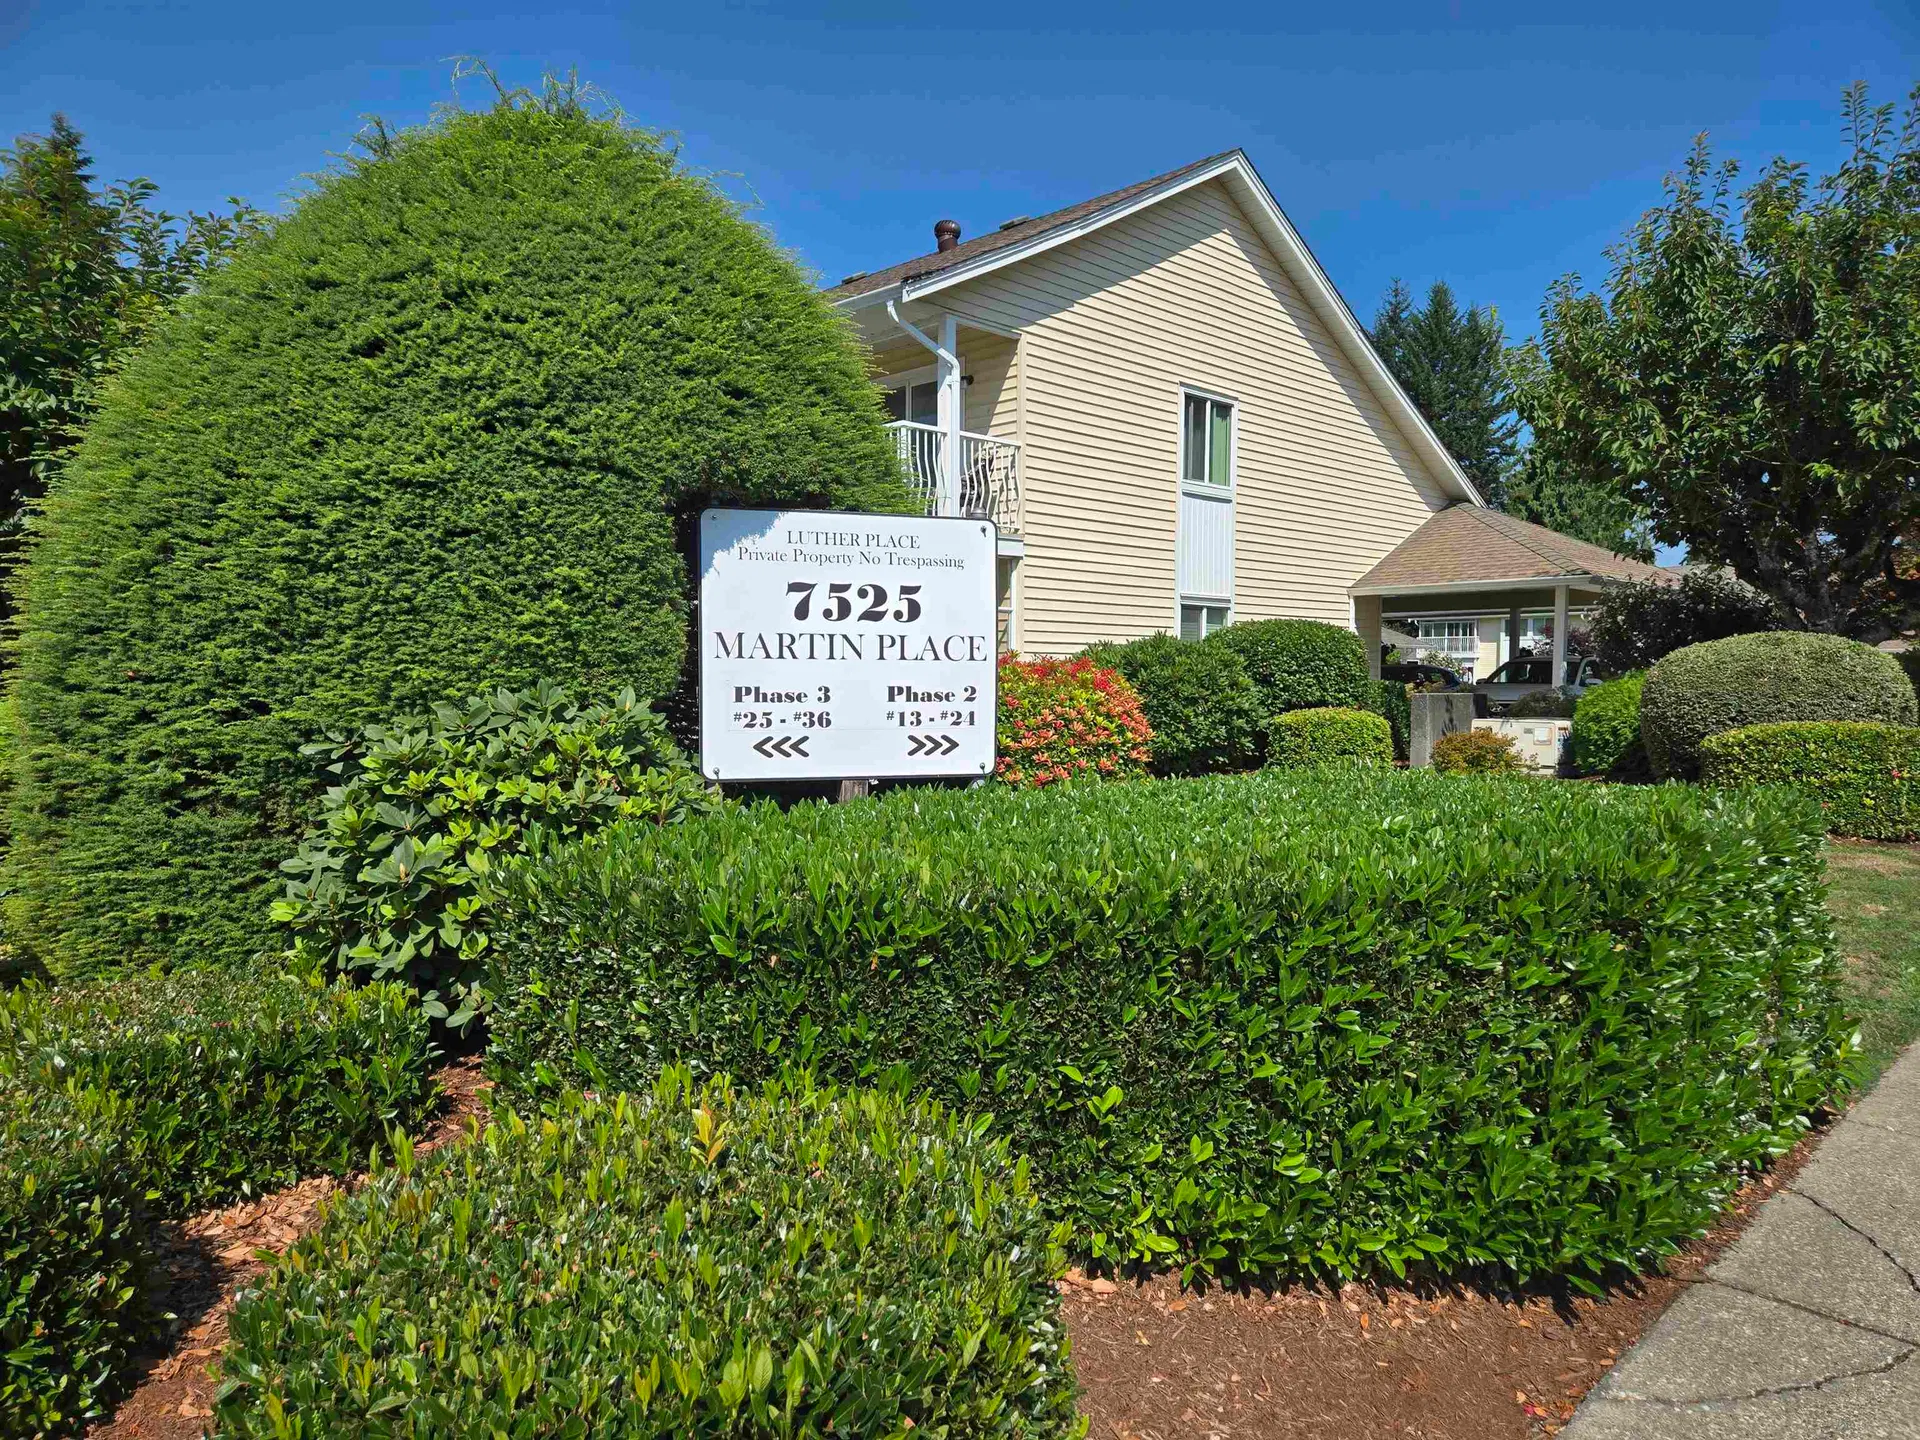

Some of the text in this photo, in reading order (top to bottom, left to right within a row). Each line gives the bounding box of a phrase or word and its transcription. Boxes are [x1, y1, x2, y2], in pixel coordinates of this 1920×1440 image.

[787, 530, 920, 549] LUTHER PLACE
[738, 547, 964, 570] Private Property No Trespassing
[786, 581, 922, 623] 7525
[713, 632, 988, 661] MARTIN PLACE
[733, 686, 831, 703] Phase 3
[887, 686, 977, 702] Phase 2
[734, 712, 772, 728] #25
[794, 711, 832, 728] #36
[886, 710, 922, 727] #13
[940, 710, 975, 726] #24
